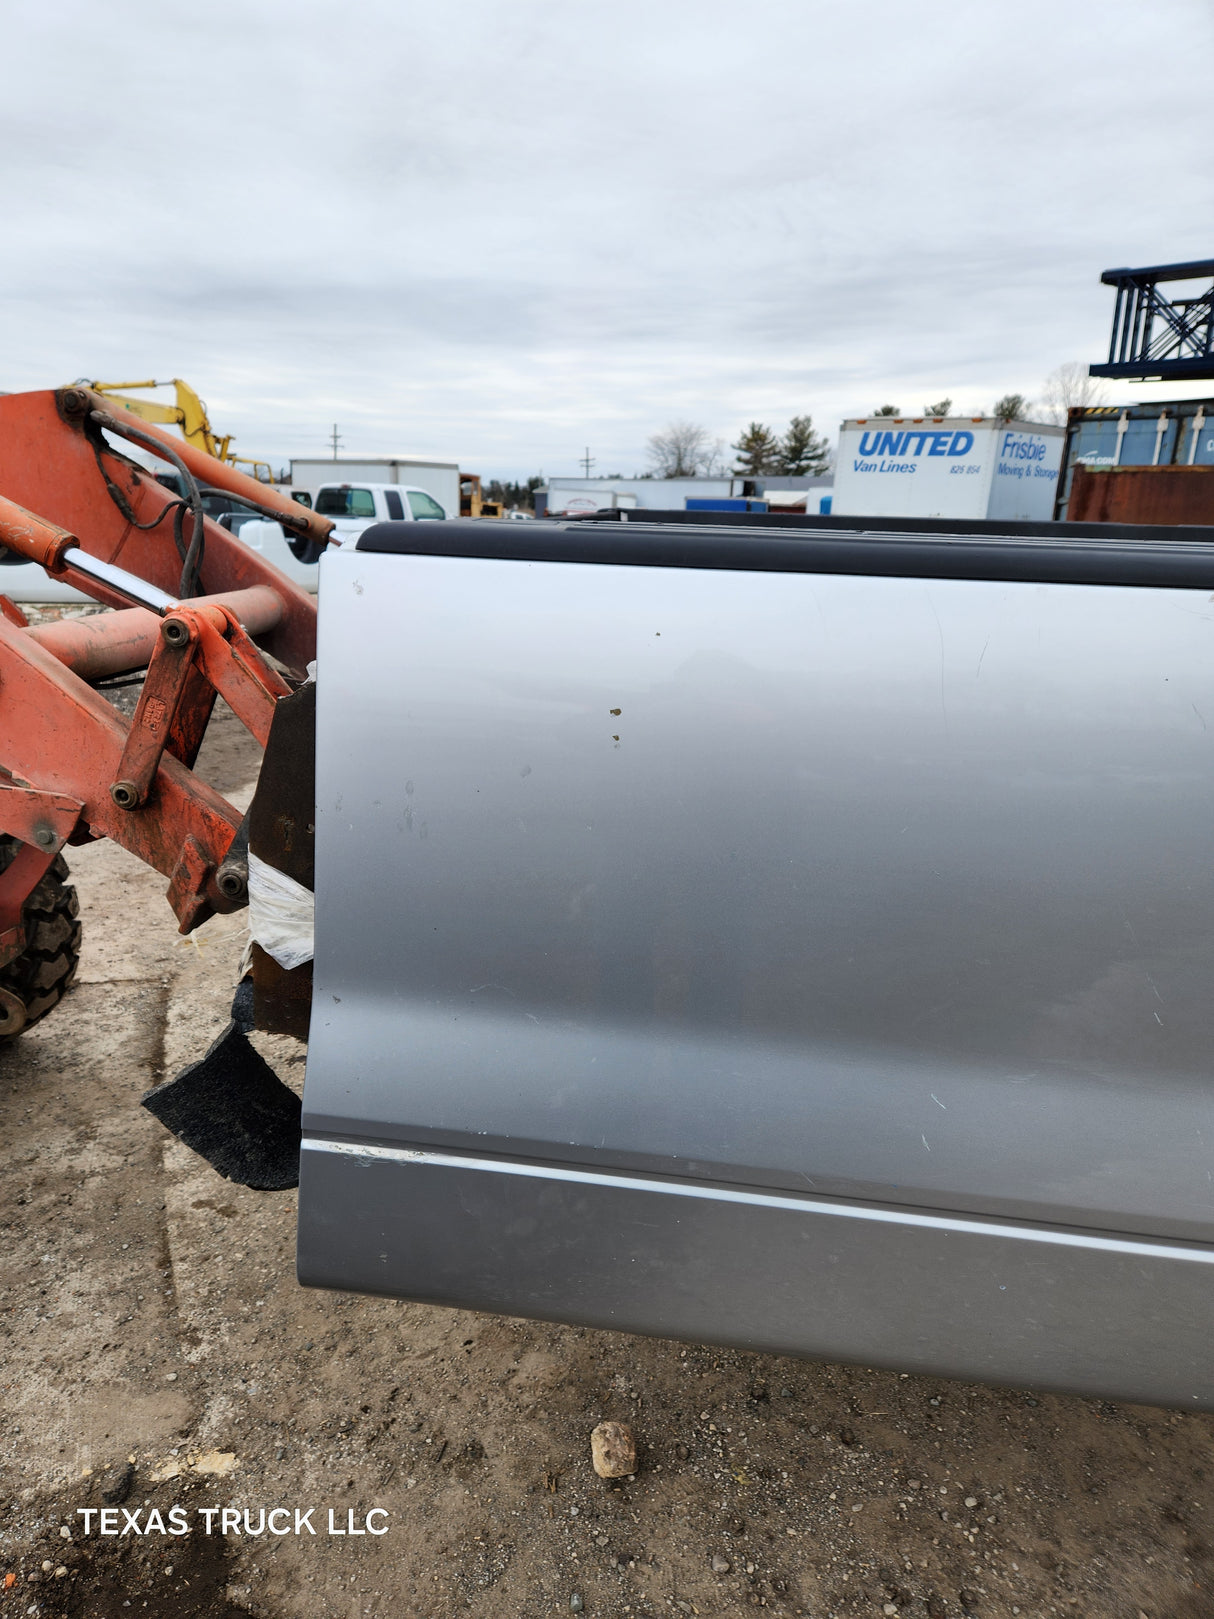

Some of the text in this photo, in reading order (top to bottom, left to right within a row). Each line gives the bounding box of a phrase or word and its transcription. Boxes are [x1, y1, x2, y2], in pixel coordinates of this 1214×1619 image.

[858, 431, 974, 456] UNITED
[1001, 433, 1046, 461] Frisbie
[853, 460, 917, 473] Van Lines
[998, 462, 1024, 479] Moving
